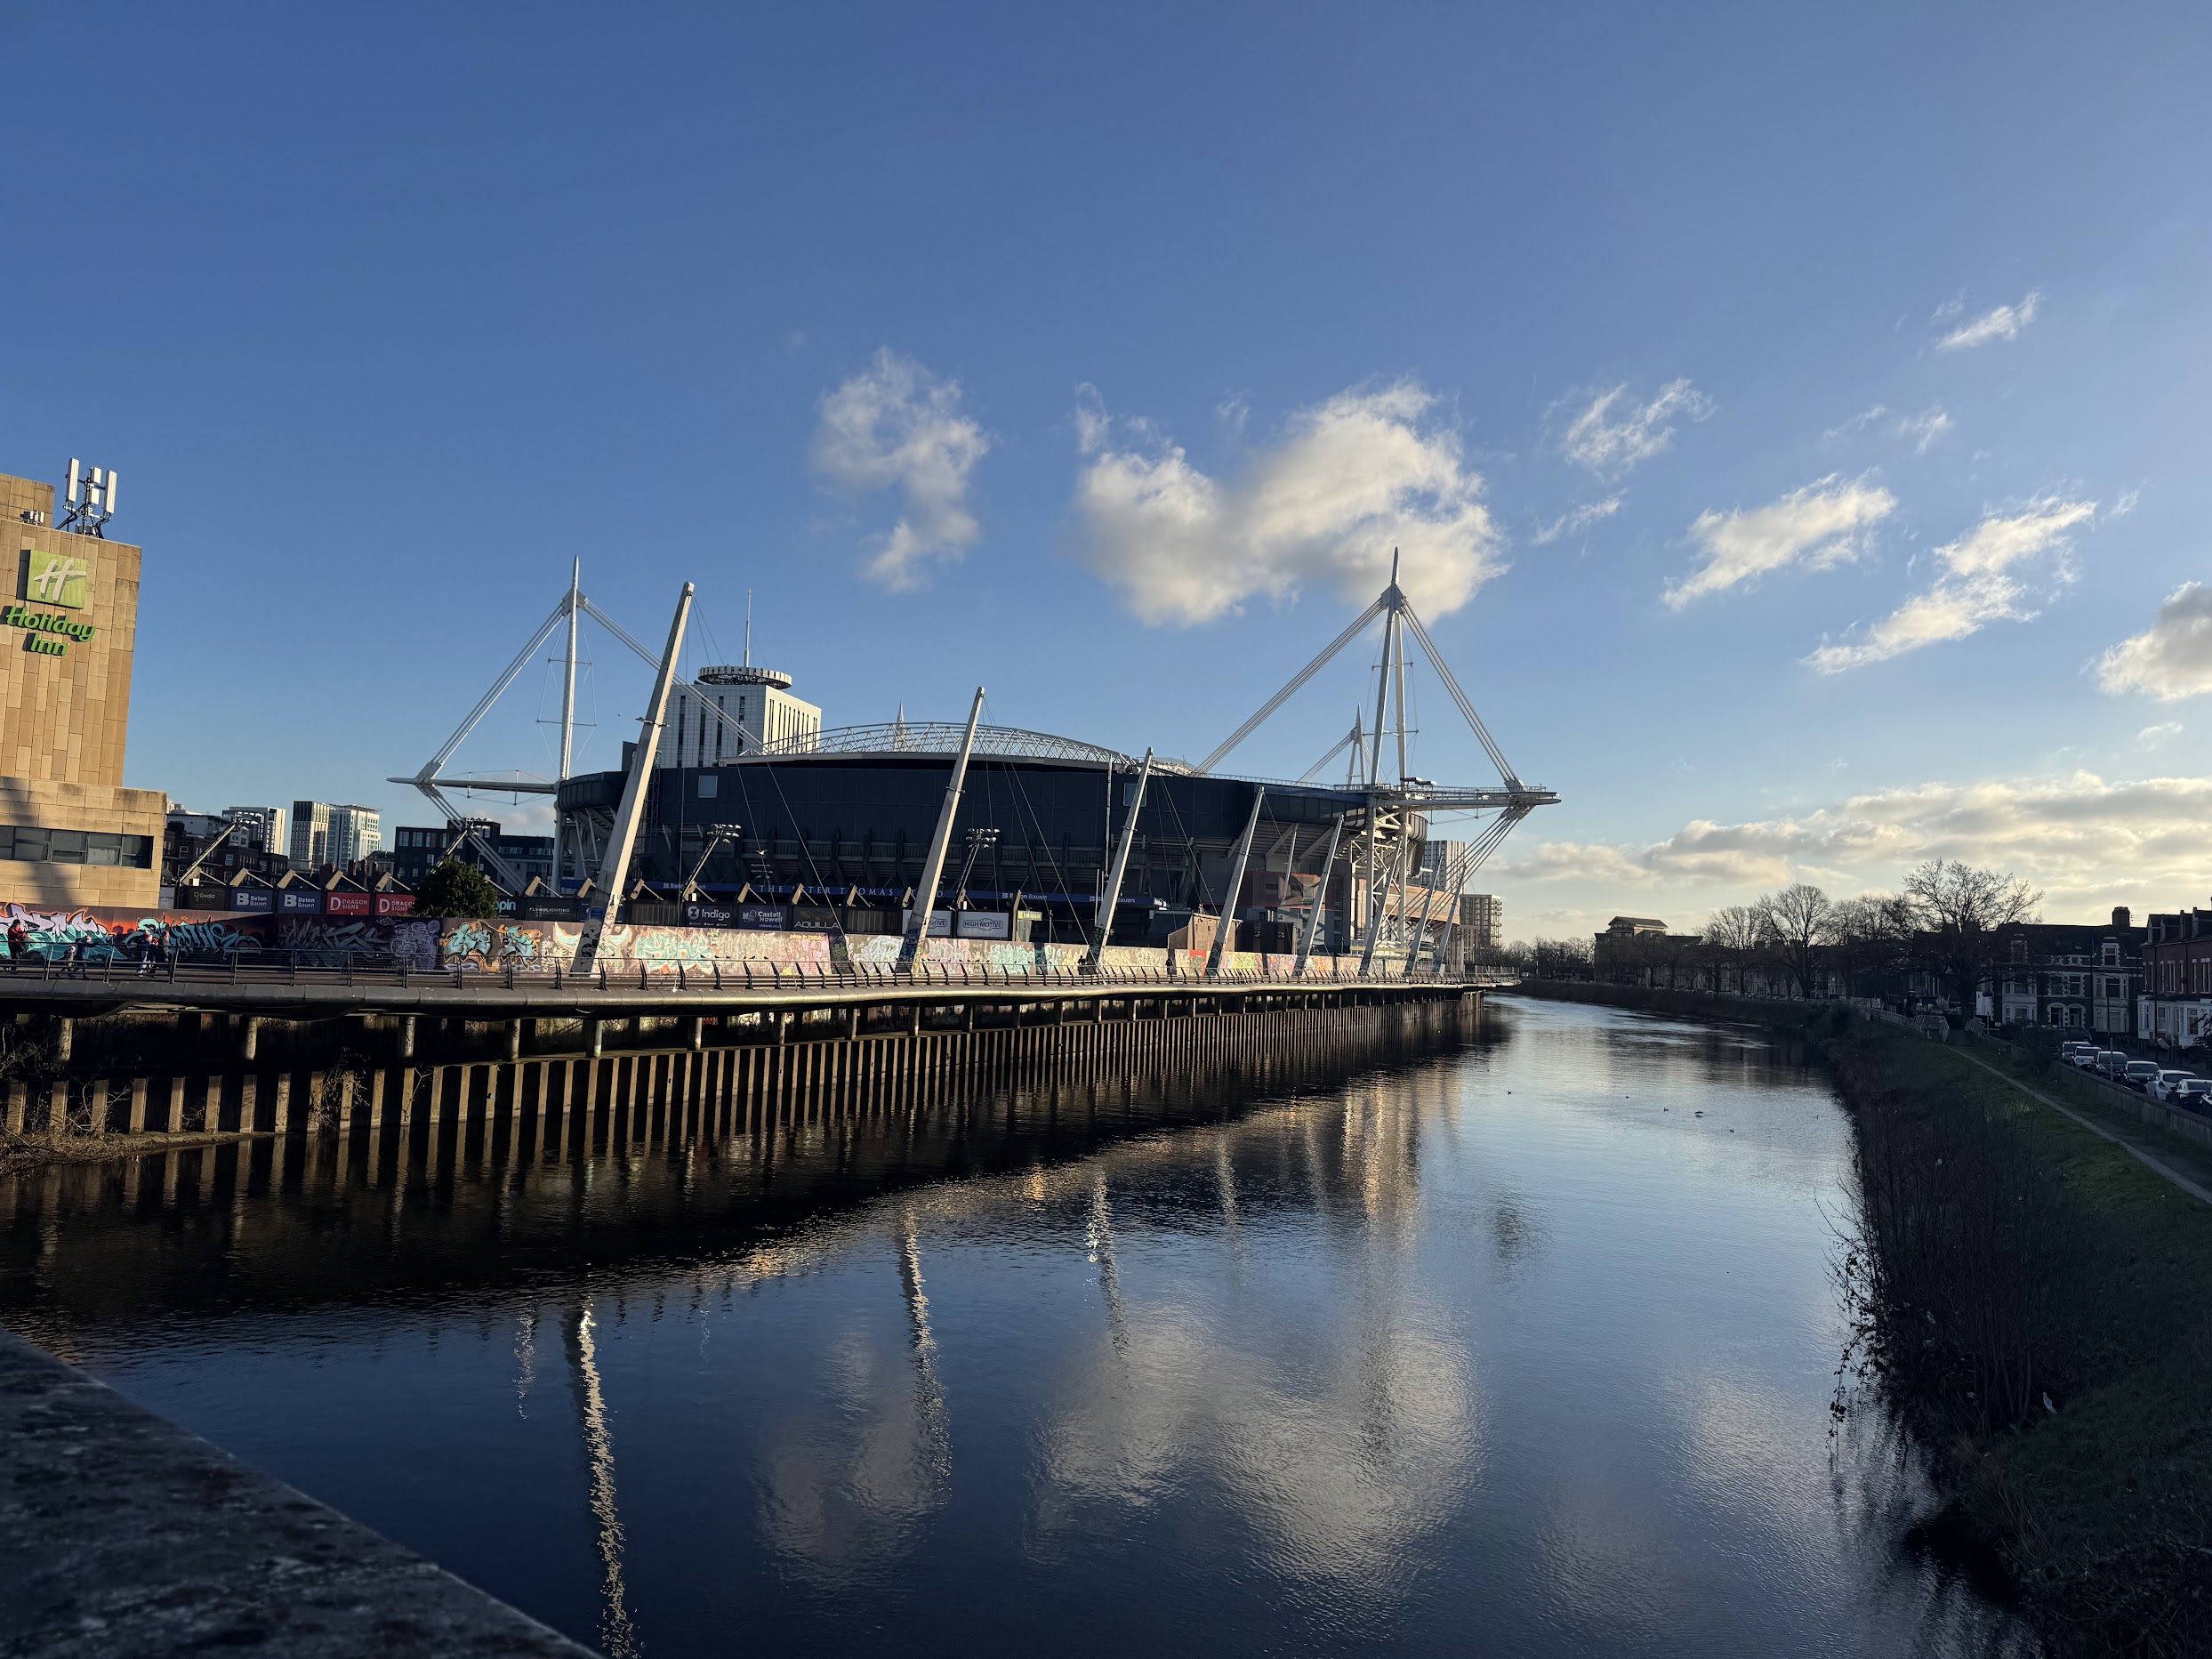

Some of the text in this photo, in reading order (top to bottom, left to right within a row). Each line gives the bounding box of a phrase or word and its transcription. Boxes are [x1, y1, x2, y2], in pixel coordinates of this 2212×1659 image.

[5, 605, 97, 642] Holiday
[30, 632, 68, 656] Inn
[760, 884, 783, 893] THE
[839, 887, 894, 897] TOMAS
[701, 908, 730, 921] Indigo
[794, 921, 840, 929] AQUILLA
[979, 922, 1002, 930] MOTIVE
